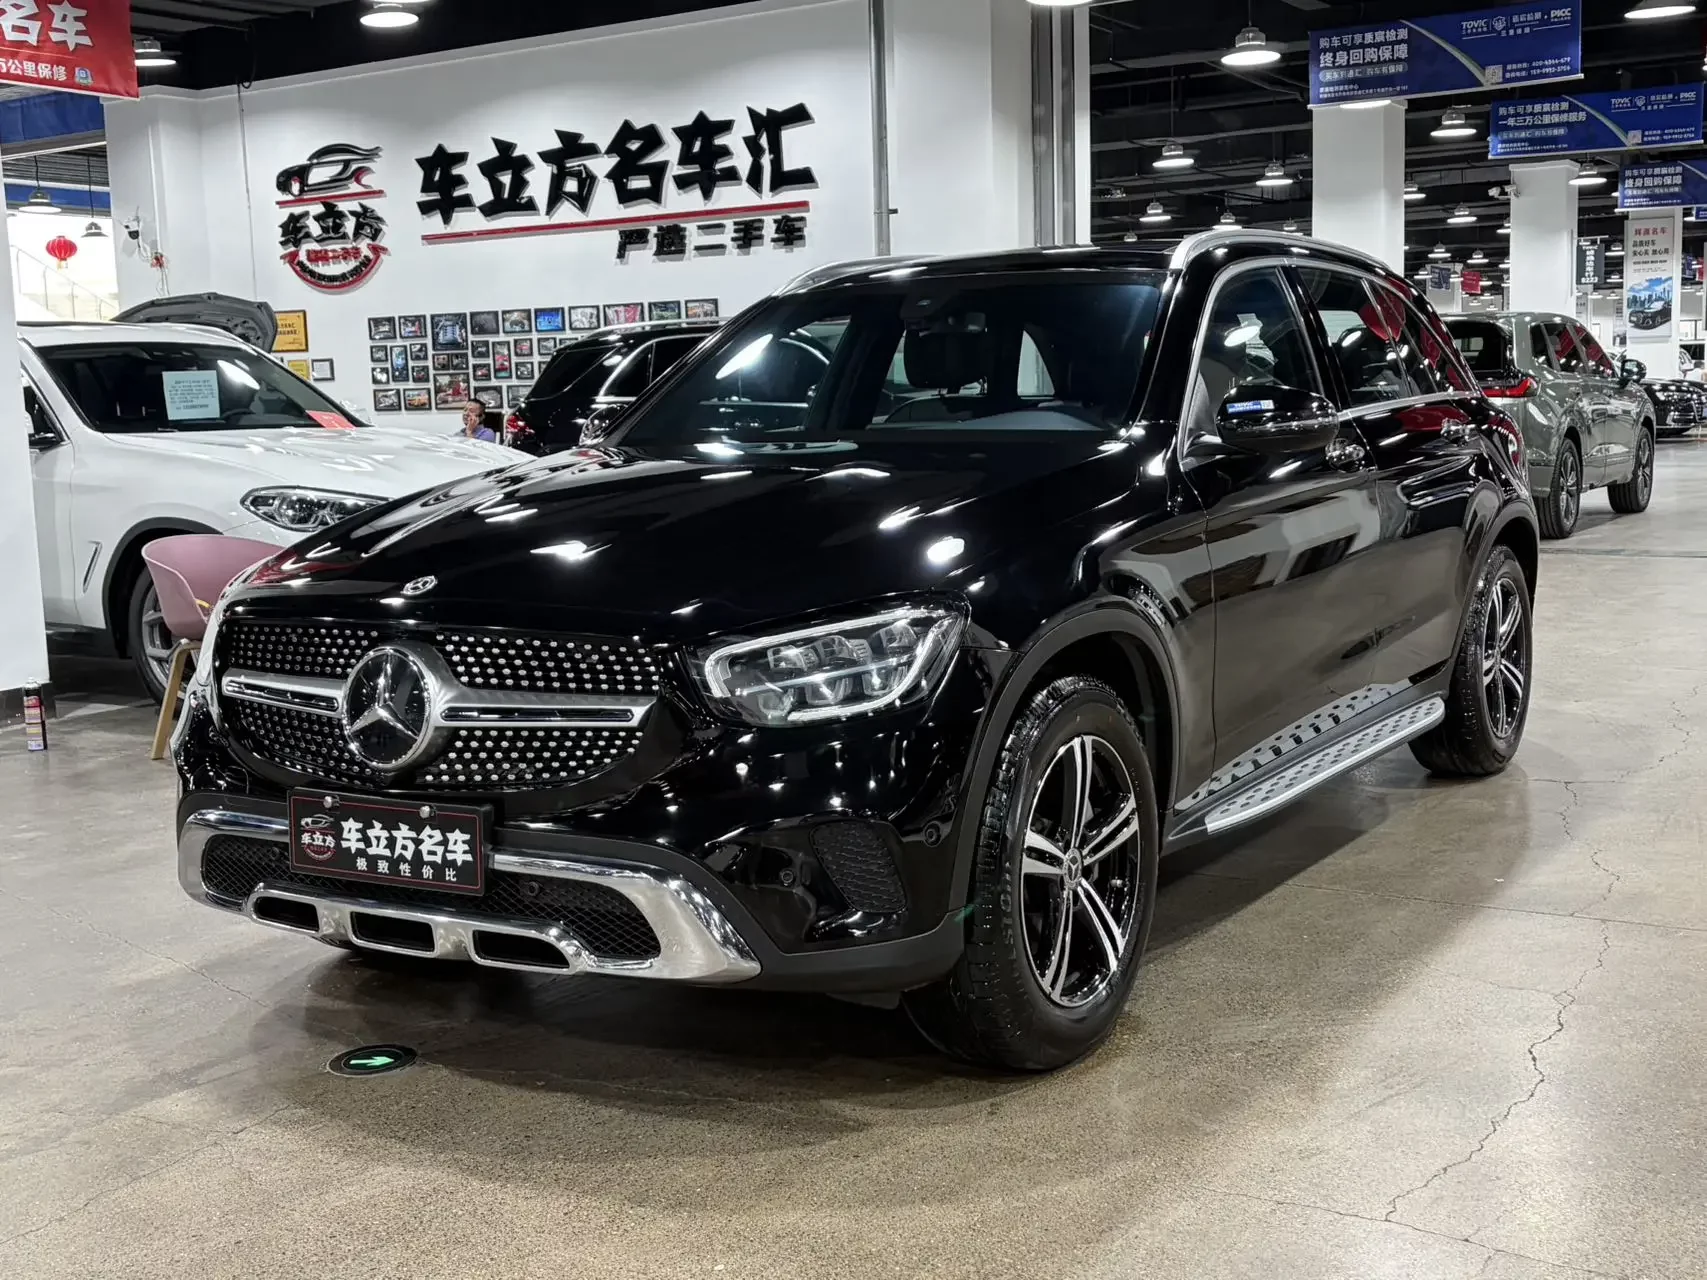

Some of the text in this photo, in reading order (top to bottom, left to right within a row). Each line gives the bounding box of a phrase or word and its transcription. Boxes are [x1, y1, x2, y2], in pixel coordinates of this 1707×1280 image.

[0, 0, 94, 52] 名车
[1319, 43, 1408, 68] 终身回购保障
[414, 102, 819, 230] 车立方名车汇
[278, 201, 386, 249] 车立方
[613, 214, 808, 265] 严选二手车
[301, 831, 336, 848] 车立方
[340, 816, 474, 867] 车立方名车
[355, 856, 457, 882] 极致性价比
